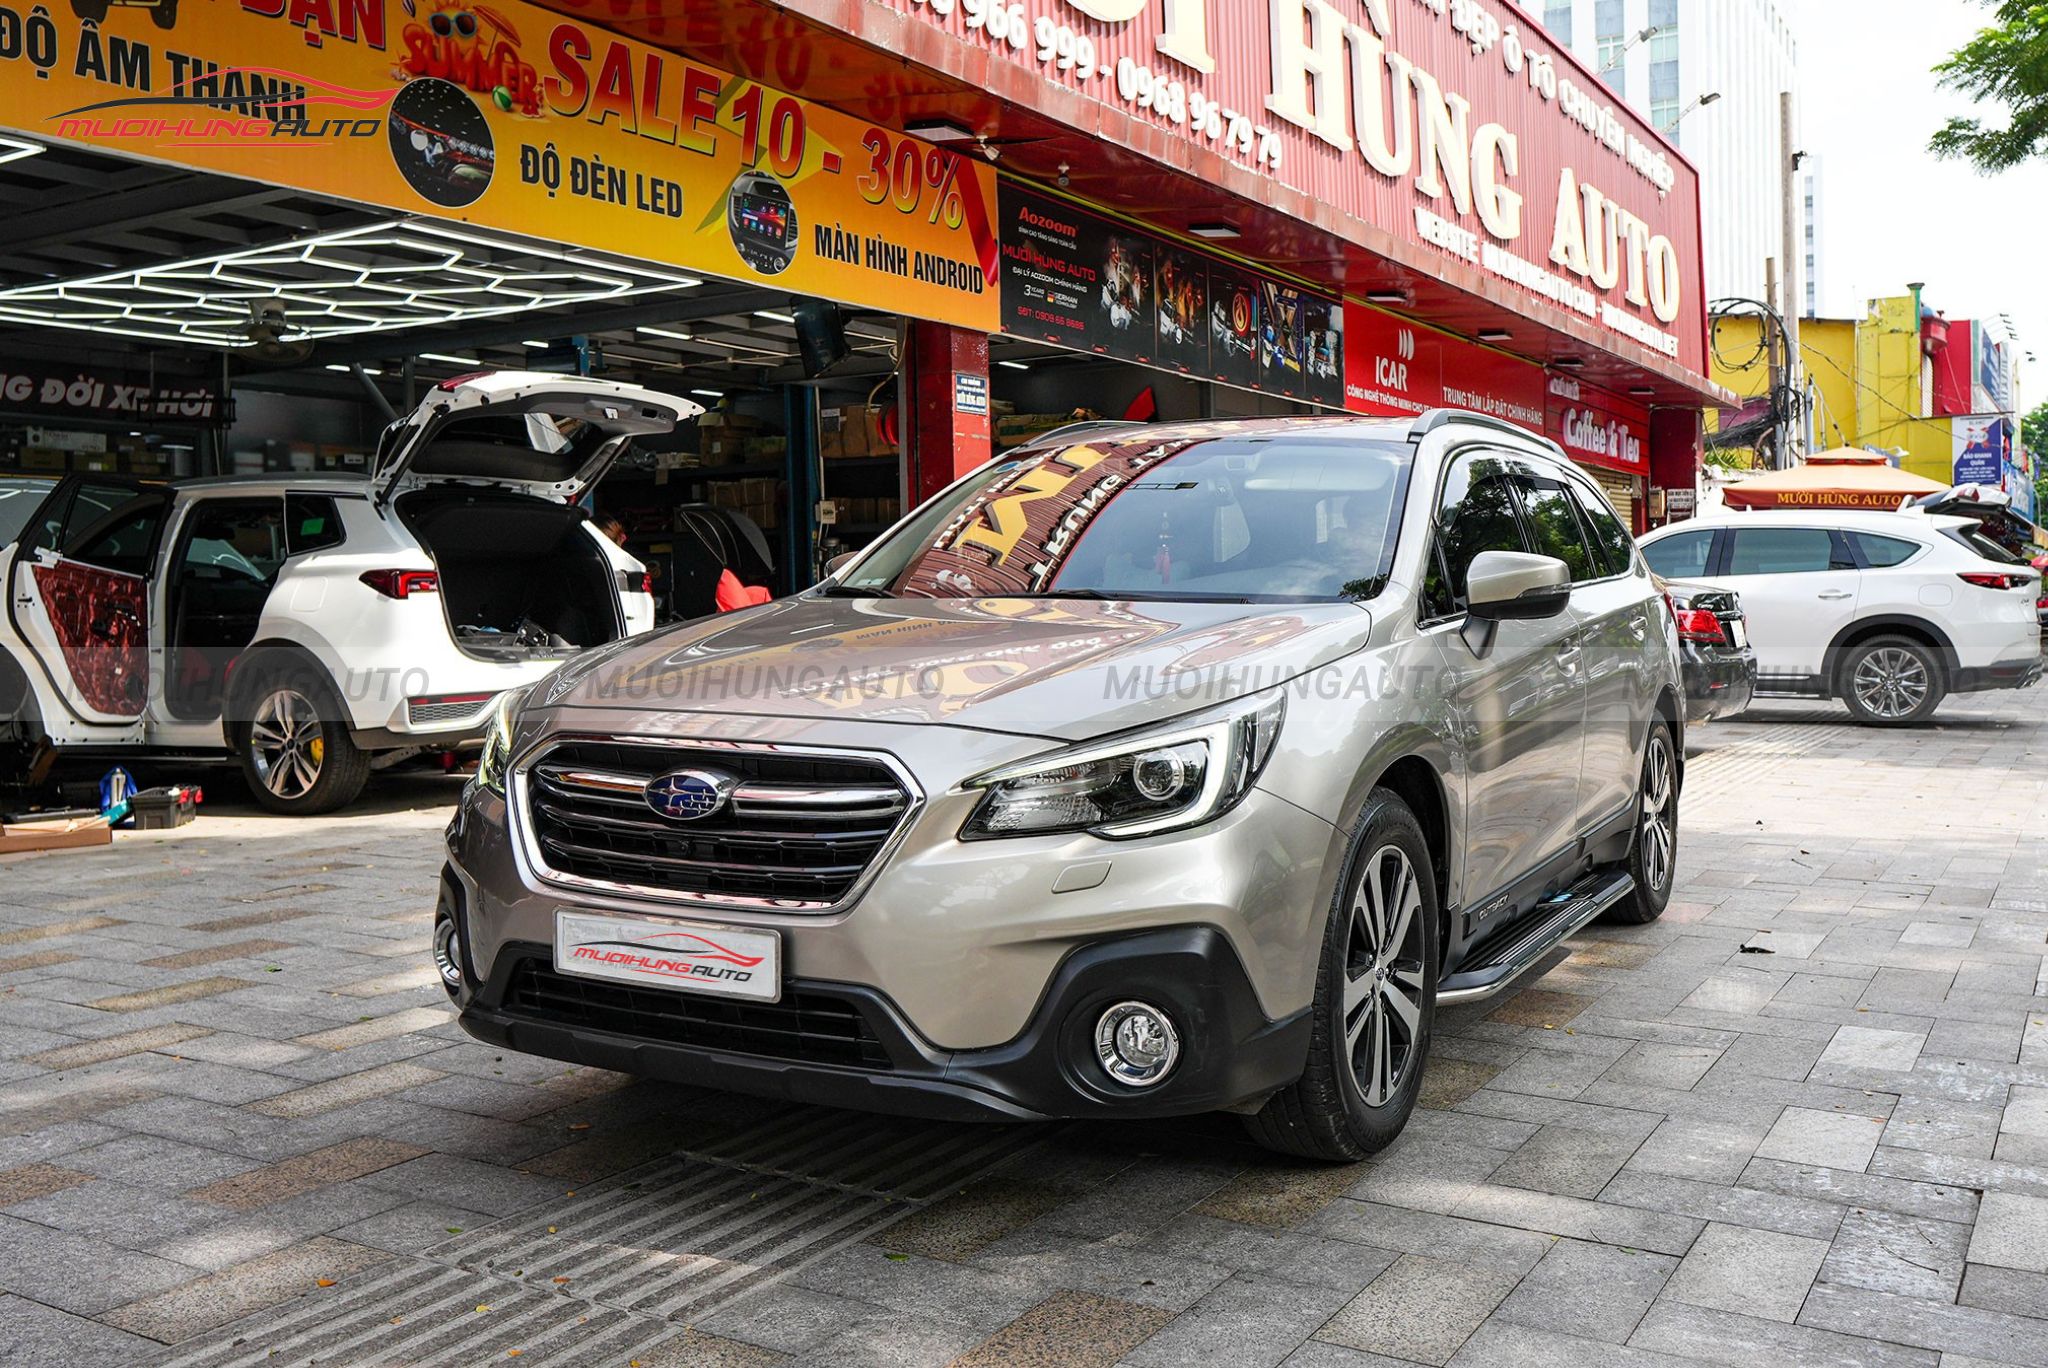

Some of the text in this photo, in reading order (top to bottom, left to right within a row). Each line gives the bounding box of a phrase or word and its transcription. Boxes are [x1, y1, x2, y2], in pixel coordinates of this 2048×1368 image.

[74, 18, 151, 93] ÂM
[165, 50, 307, 125] THANH
[1034, 16, 1095, 79] 999
[1117, 57, 1186, 124] 0968
[1502, 25, 1523, 72] Ô
[1525, 48, 1556, 99] TÔ
[1558, 79, 1625, 157] CHUYÊN
[402, 22, 543, 118] SUMMER
[543, 22, 721, 157] SALE
[731, 83, 806, 180] 10
[856, 127, 964, 230] 30%
[520, 142, 683, 218] ĐỘ ĐÈN LED
[1265, 0, 1680, 322] HÙNG AUTO
[1018, 206, 1077, 238] Aozoom
[814, 222, 984, 295] MÀN HÌNH ANDROID
[1067, 263, 1096, 281] AUTO
[1023, 284, 1031, 296] 3
[40, 374, 104, 408] ĐỜI
[1375, 355, 1408, 392] ICAR
[1346, 384, 1363, 399] CÔNG
[1364, 388, 1380, 405] NGHỆ
[1379, 391, 1398, 408] THÔNG
[1411, 401, 1424, 414] CHO
[1443, 386, 1467, 407] TRUNG
[1467, 391, 1482, 409] TÂM
[1507, 401, 1526, 421] CHÍNH
[1526, 409, 1543, 425] HÃNG
[1563, 407, 1640, 463] Coffee & Tea
[1777, 488, 1902, 505] MƯỜI HÙNG AUTO
